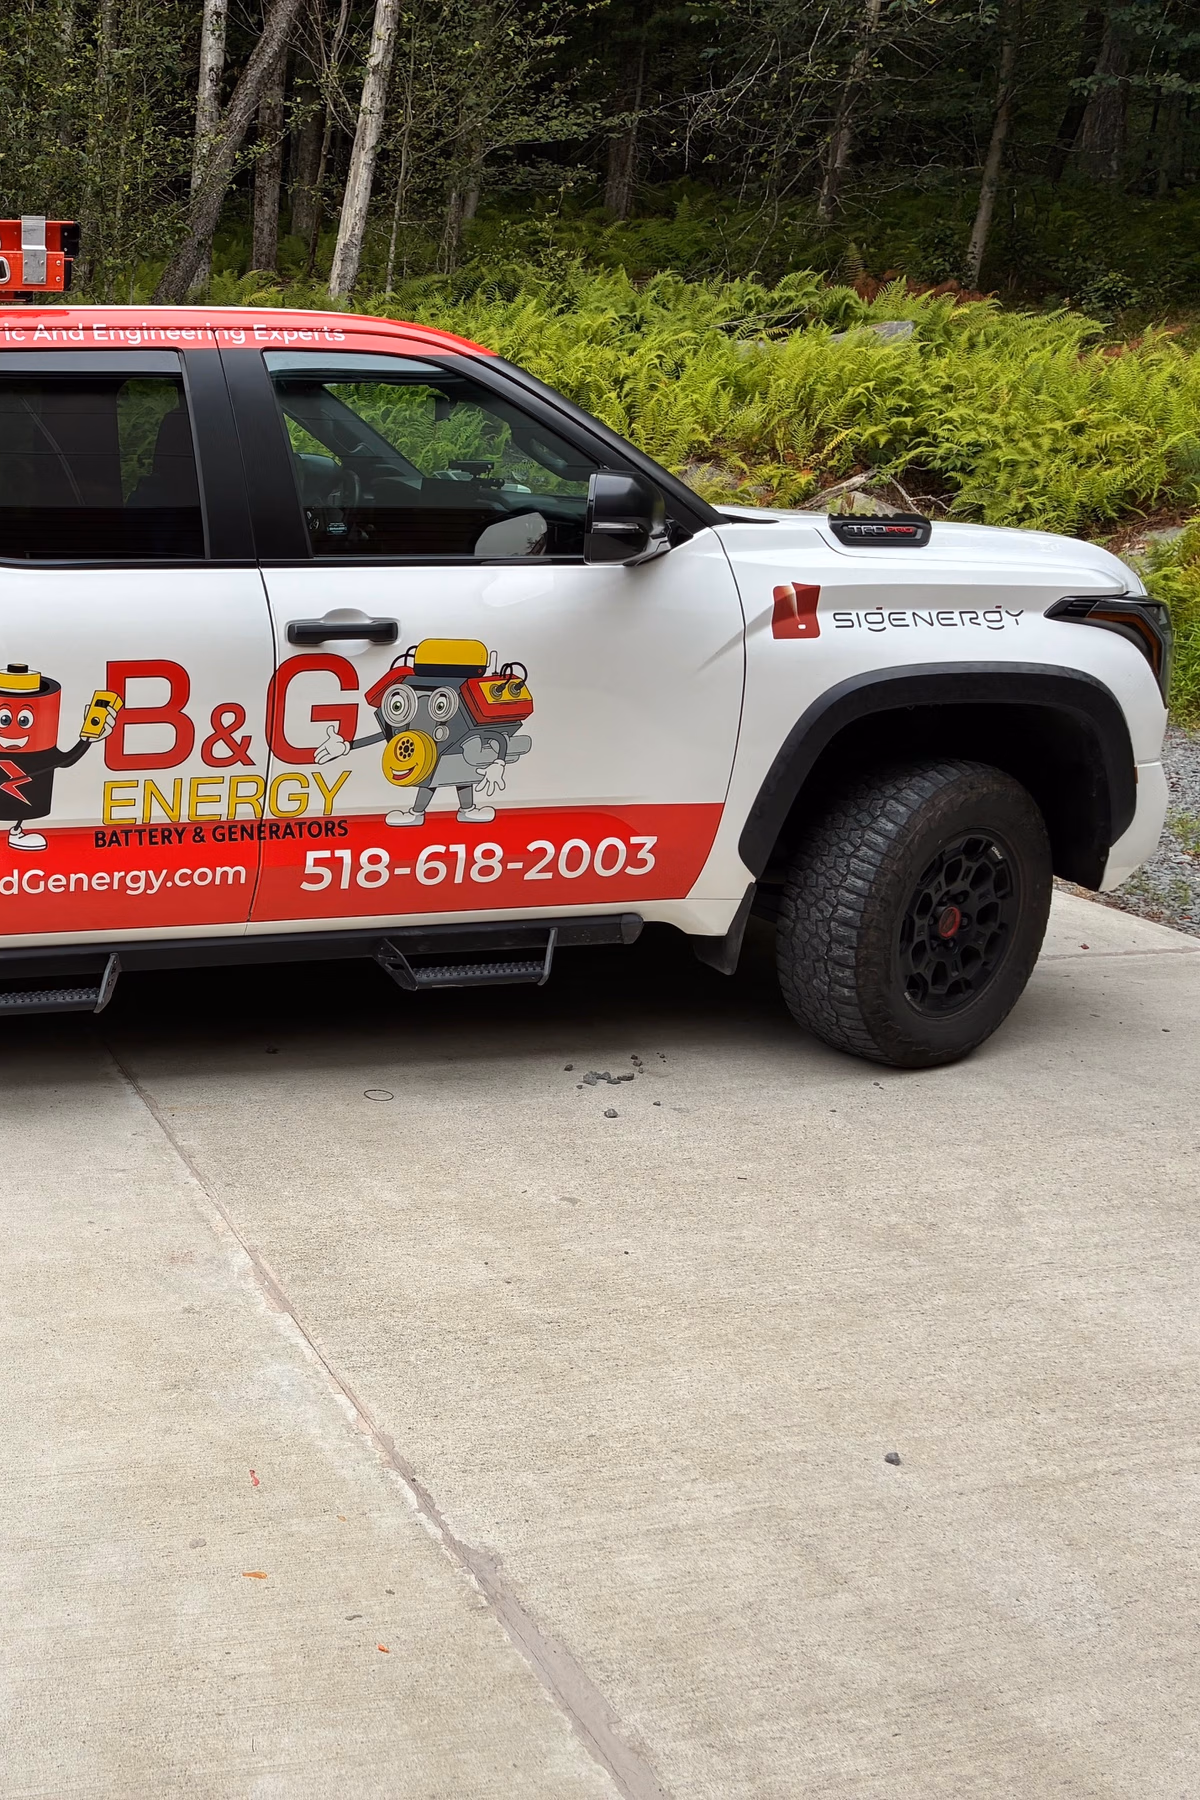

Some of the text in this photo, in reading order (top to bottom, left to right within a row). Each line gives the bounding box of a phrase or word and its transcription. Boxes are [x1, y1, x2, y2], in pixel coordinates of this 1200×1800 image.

[33, 322, 83, 341] And
[93, 322, 245, 344] Engineering
[253, 324, 345, 344] Experts
[104, 653, 360, 771] B&G
[102, 770, 352, 826] ENERGY
[94, 819, 349, 848] BATTERY & GENERATORS
[300, 835, 658, 891] 518-618-2003
